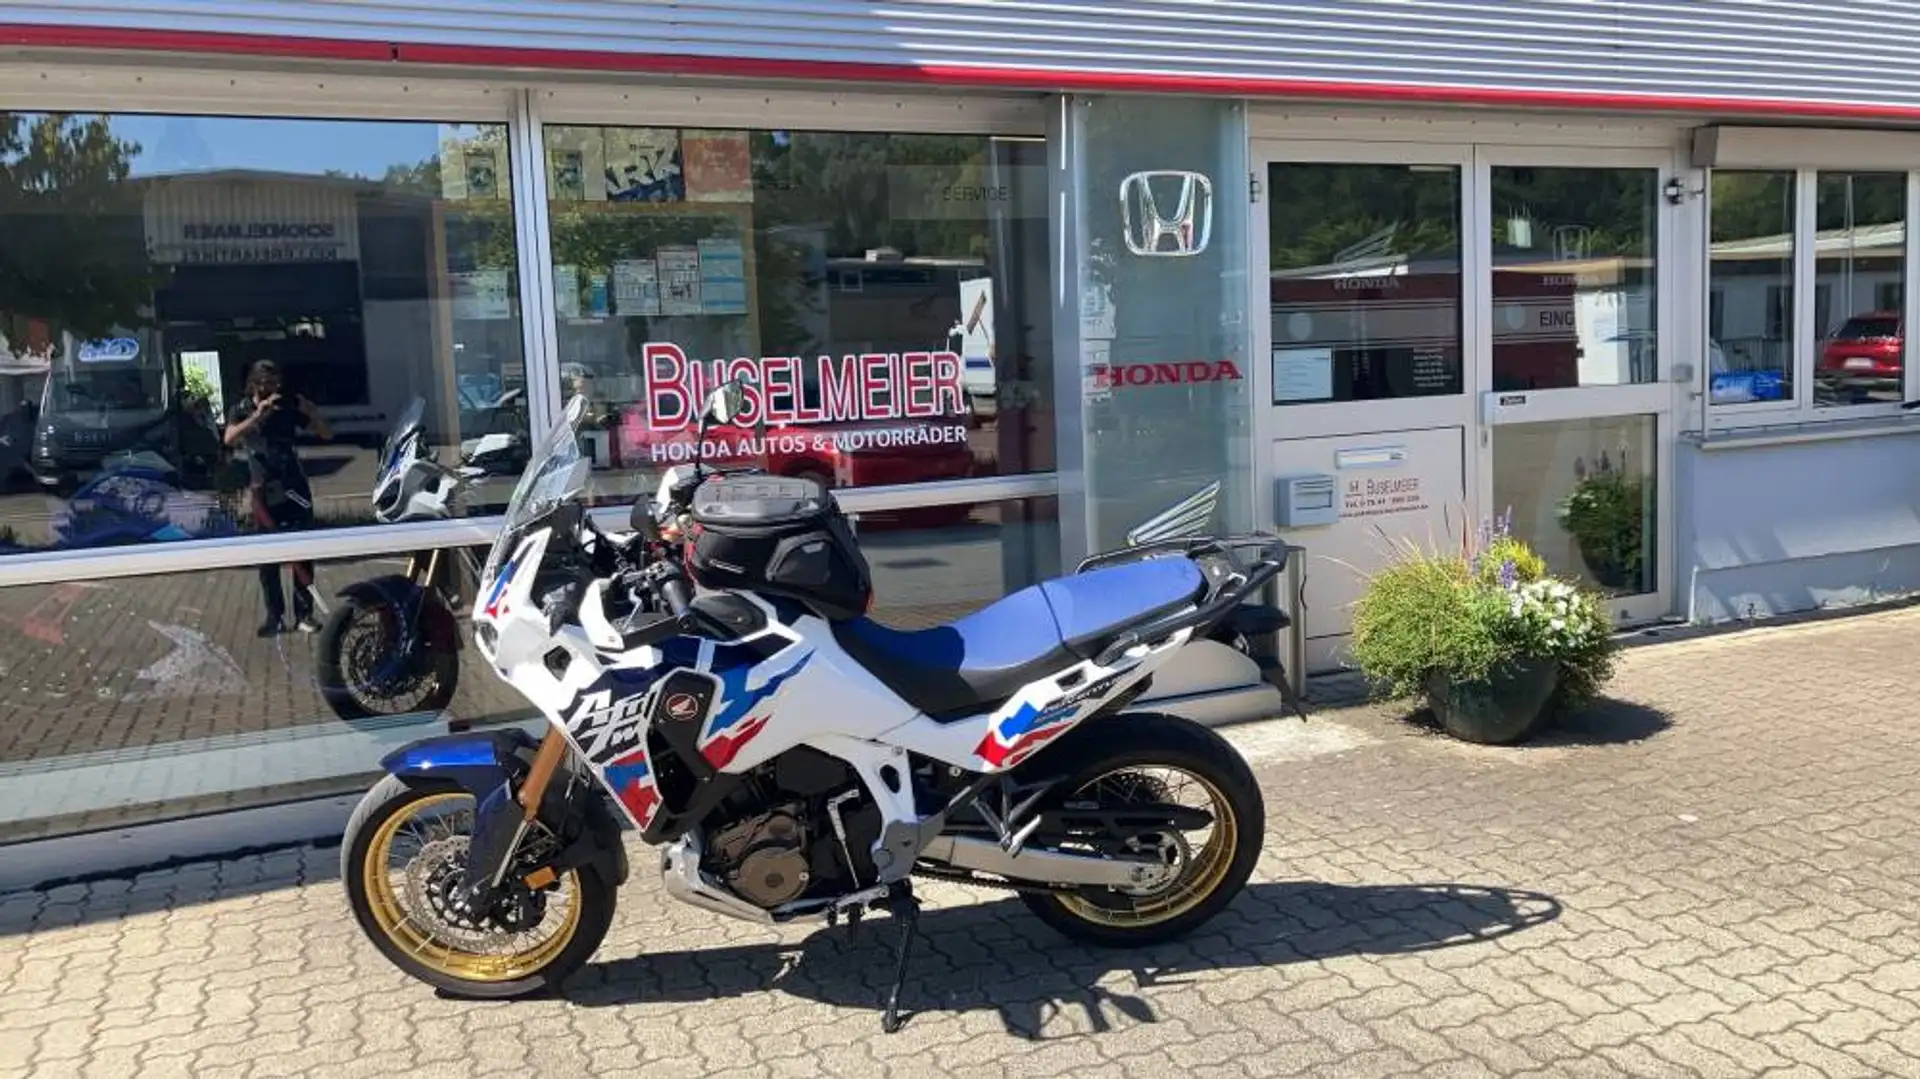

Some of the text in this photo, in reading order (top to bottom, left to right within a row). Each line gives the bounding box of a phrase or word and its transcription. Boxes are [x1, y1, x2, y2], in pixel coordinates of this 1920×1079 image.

[942, 186, 1009, 201] SERVICE
[1333, 276, 1400, 290] HONDA
[1540, 311, 1576, 327] EING
[1089, 360, 1244, 388] HONDA
[643, 342, 966, 432] BUSELMEIER
[651, 423, 968, 462] HONDA AUTOS & MOTORRÄDER
